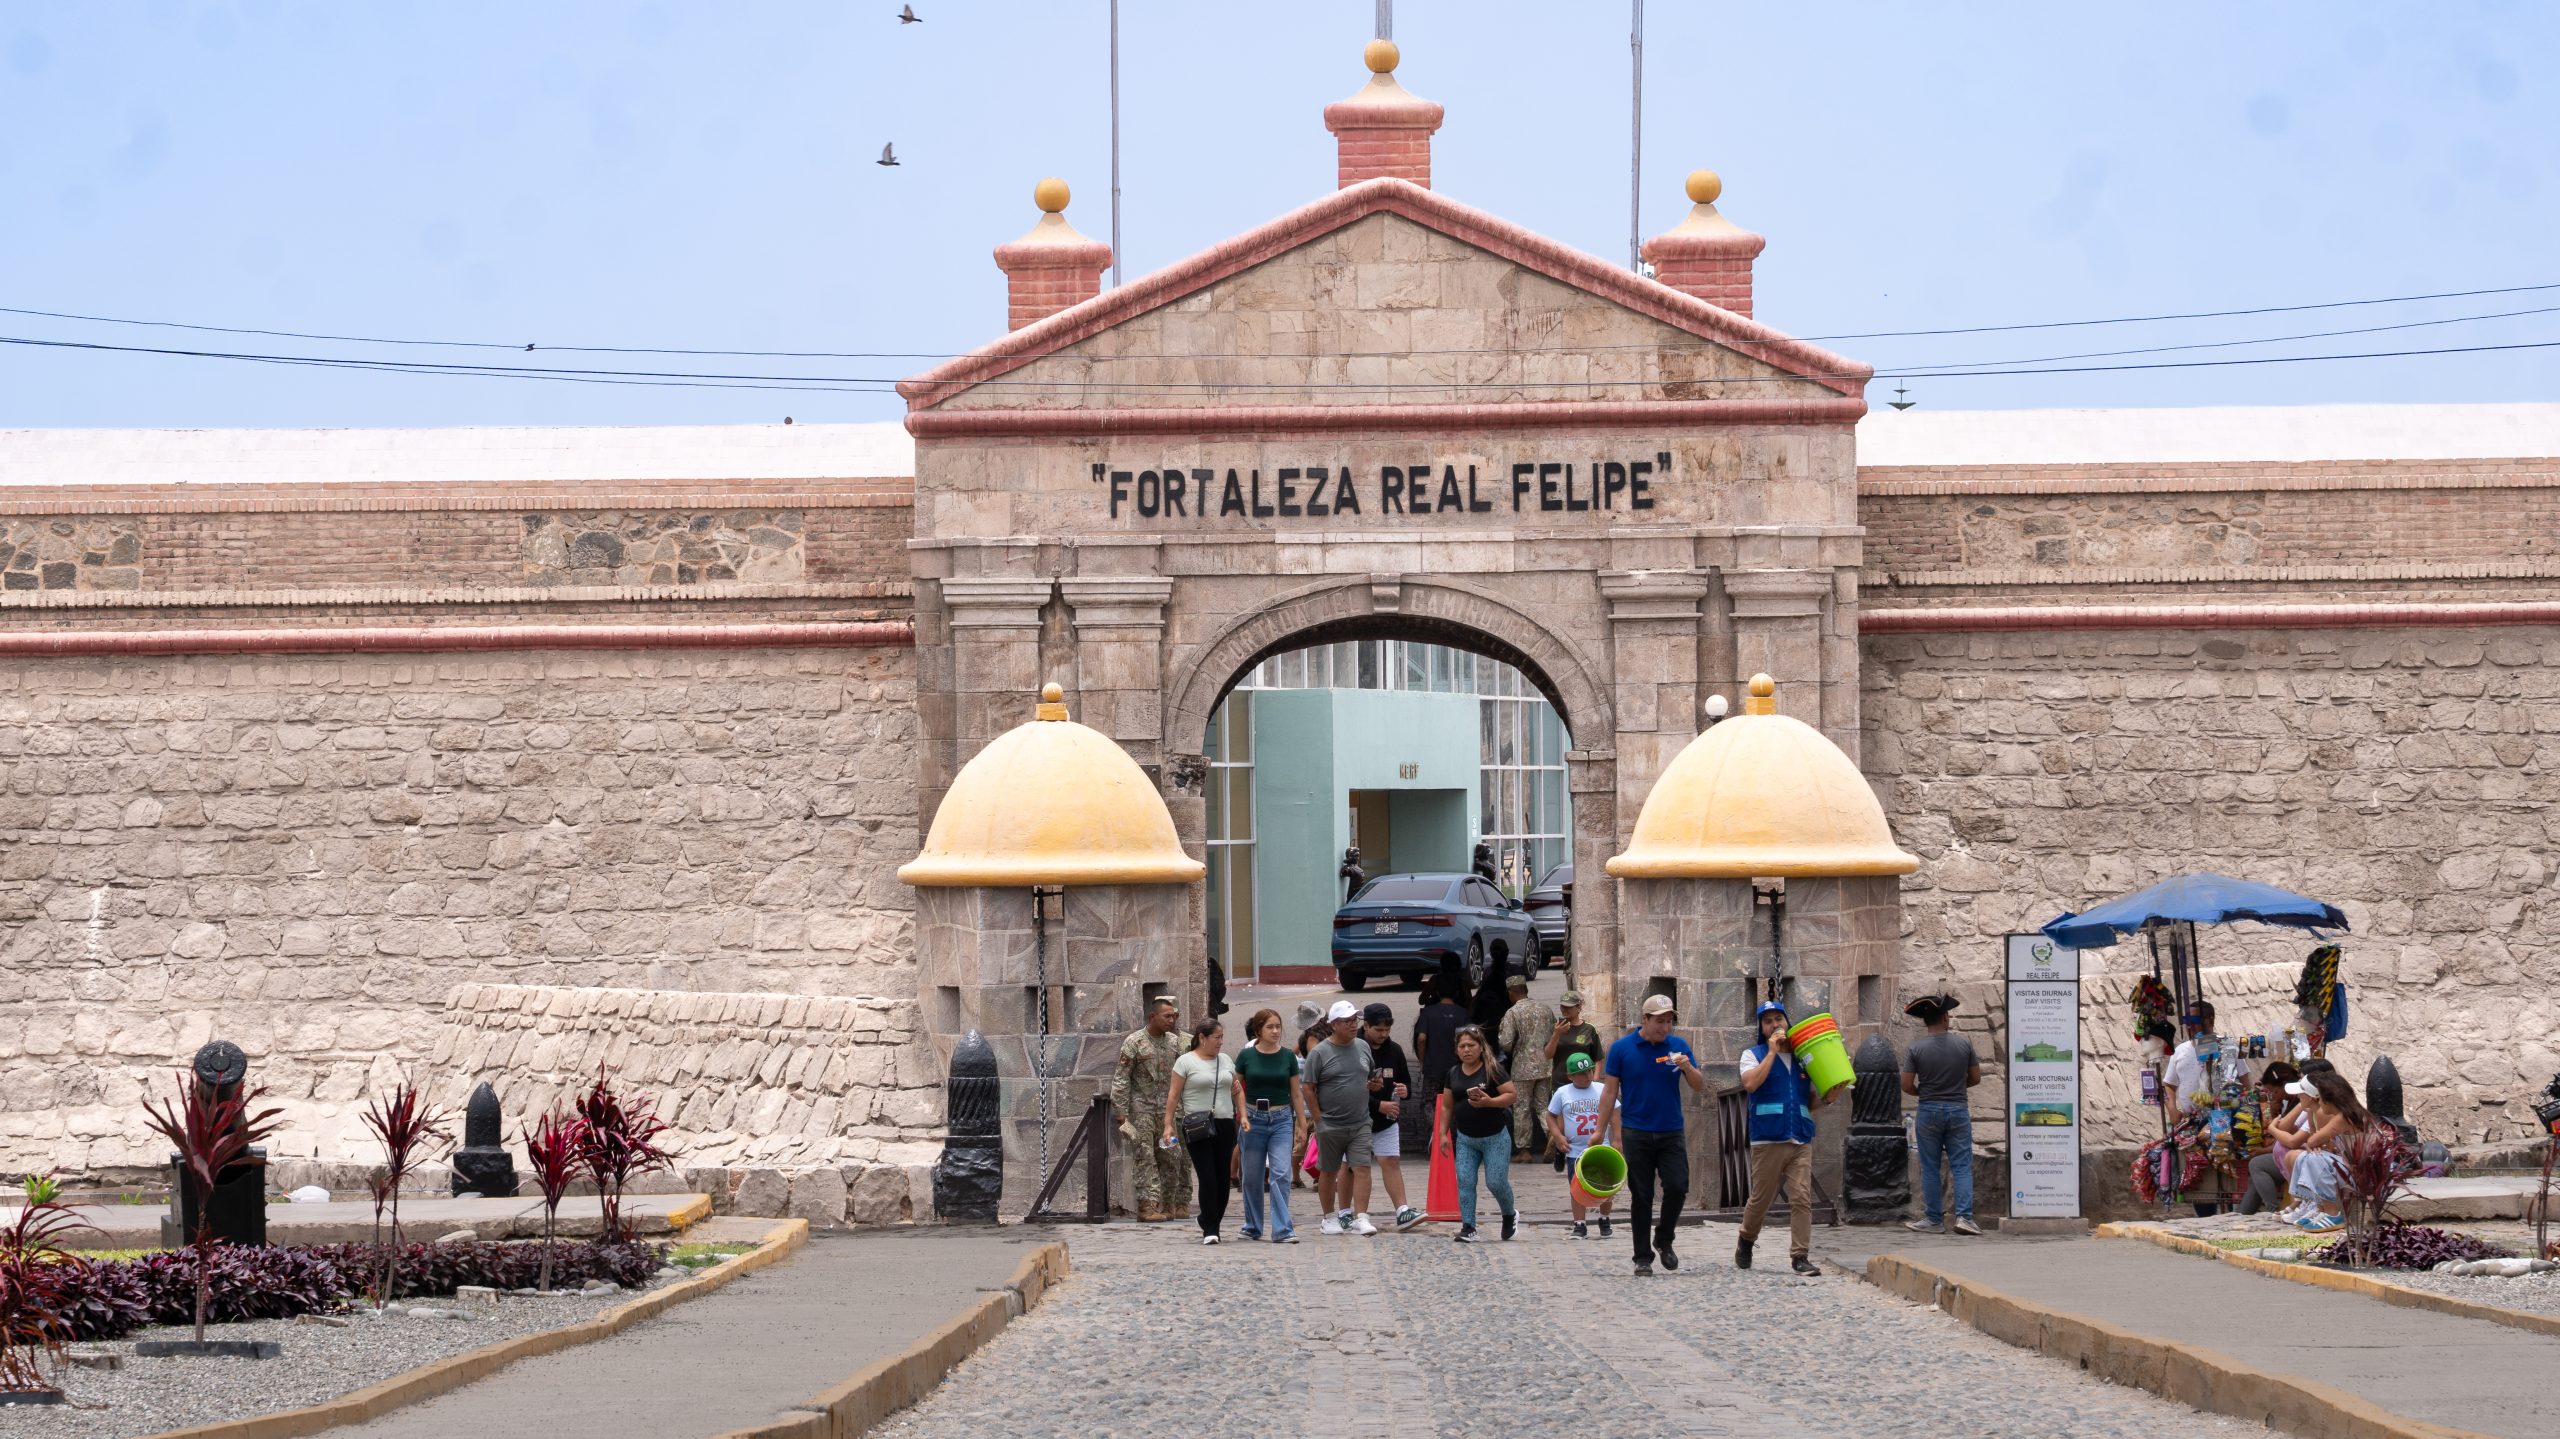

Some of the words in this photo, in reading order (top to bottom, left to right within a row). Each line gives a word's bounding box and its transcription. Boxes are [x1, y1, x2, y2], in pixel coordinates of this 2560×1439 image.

[1092, 464, 1361, 519] "FORTALEZA
[1383, 465, 1493, 515] REAL
[1513, 452, 1672, 511] FELIPE"
[1411, 589, 1496, 628] CAMINO
[1575, 1114, 1599, 1136] 23
